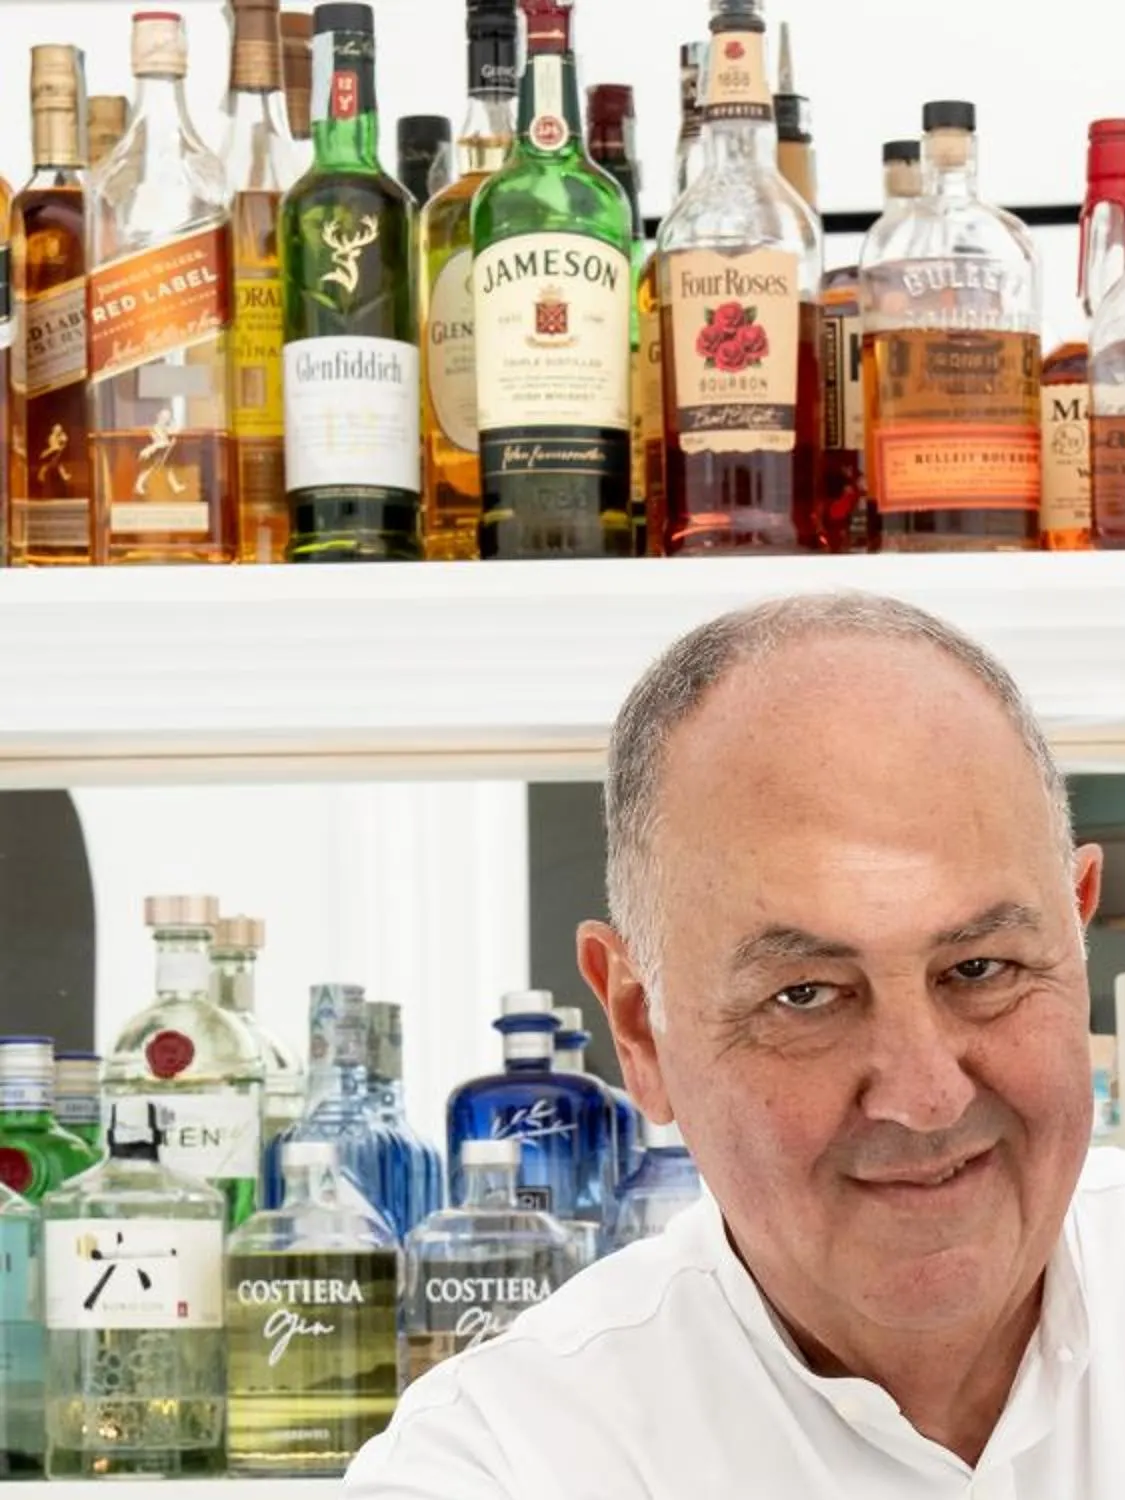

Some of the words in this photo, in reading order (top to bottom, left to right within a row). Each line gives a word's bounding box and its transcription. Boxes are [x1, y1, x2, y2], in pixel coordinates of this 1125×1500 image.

[483, 249, 618, 294] JAMESON
[681, 270, 723, 298] Four
[724, 268, 789, 298] Roses
[91, 294, 137, 325] RED
[142, 265, 218, 304] LABEL
[296, 349, 403, 385] Glenfiddich
[698, 377, 768, 393] BOURBON
[238, 1278, 365, 1305] COSTIERA
[425, 1277, 551, 1303] COSTIERA
